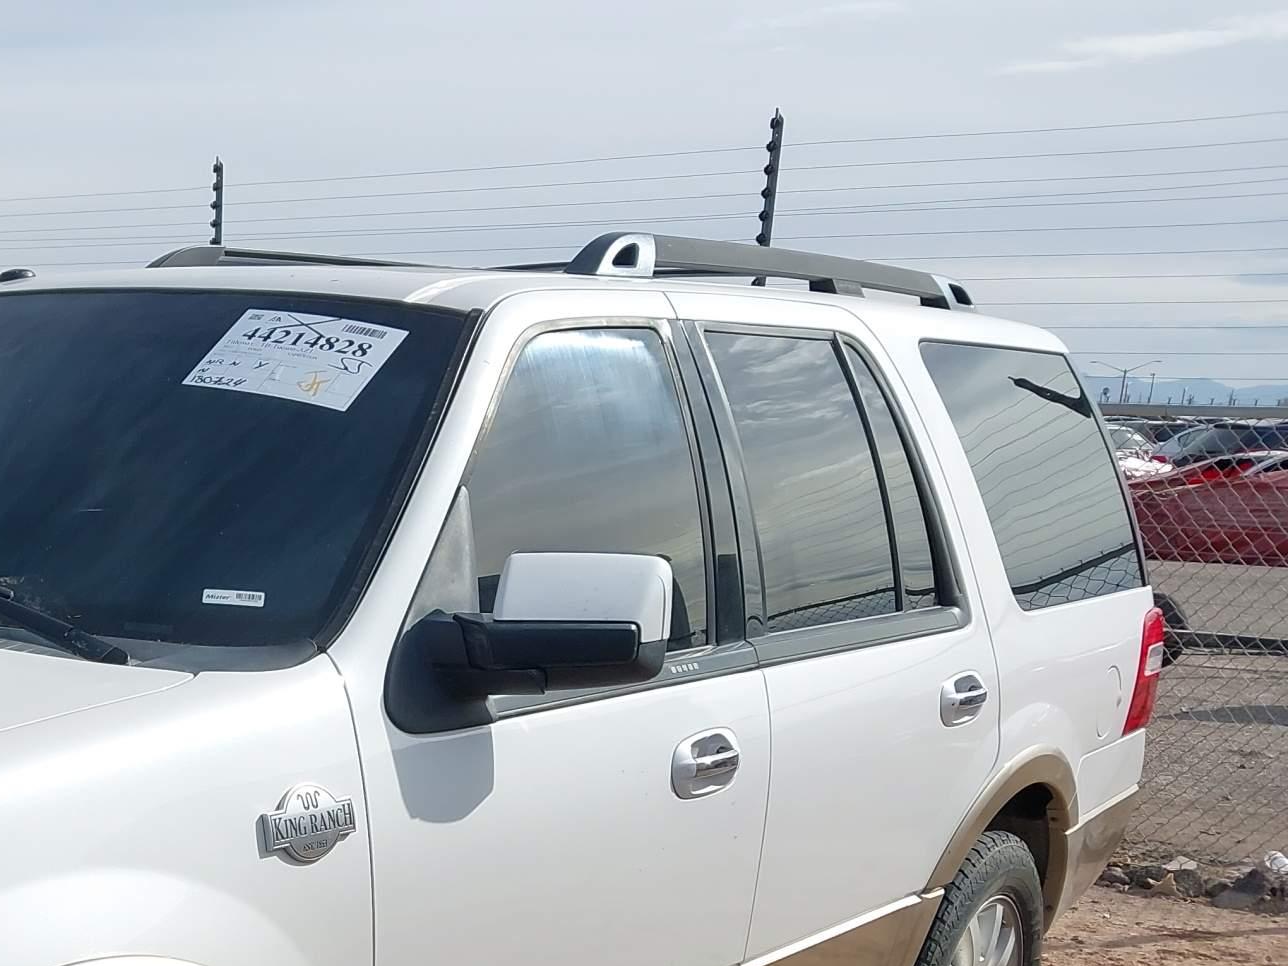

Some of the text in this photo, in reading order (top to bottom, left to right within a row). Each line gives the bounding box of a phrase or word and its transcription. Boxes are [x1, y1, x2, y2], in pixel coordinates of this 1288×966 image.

[242, 326, 373, 358] 44214828
[272, 802, 354, 842] KING RANCH
